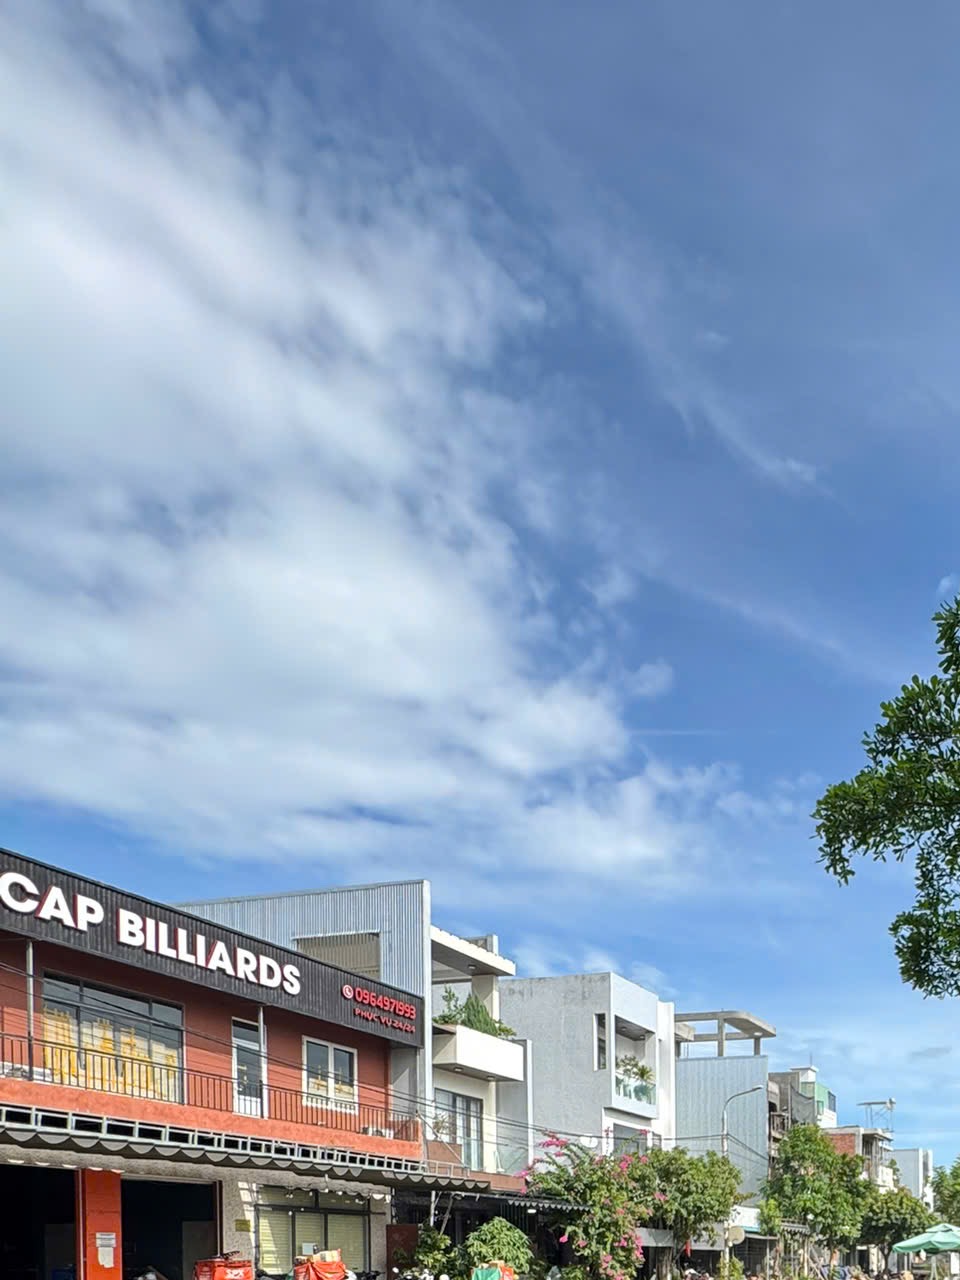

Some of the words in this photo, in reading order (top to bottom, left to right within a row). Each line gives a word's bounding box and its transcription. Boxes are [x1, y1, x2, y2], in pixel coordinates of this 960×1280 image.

[0, 872, 104, 932] CAP
[117, 908, 301, 996] BILLIARDS
[355, 987, 416, 1019] 0964971993
[393, 1020, 416, 1033] 24/24
